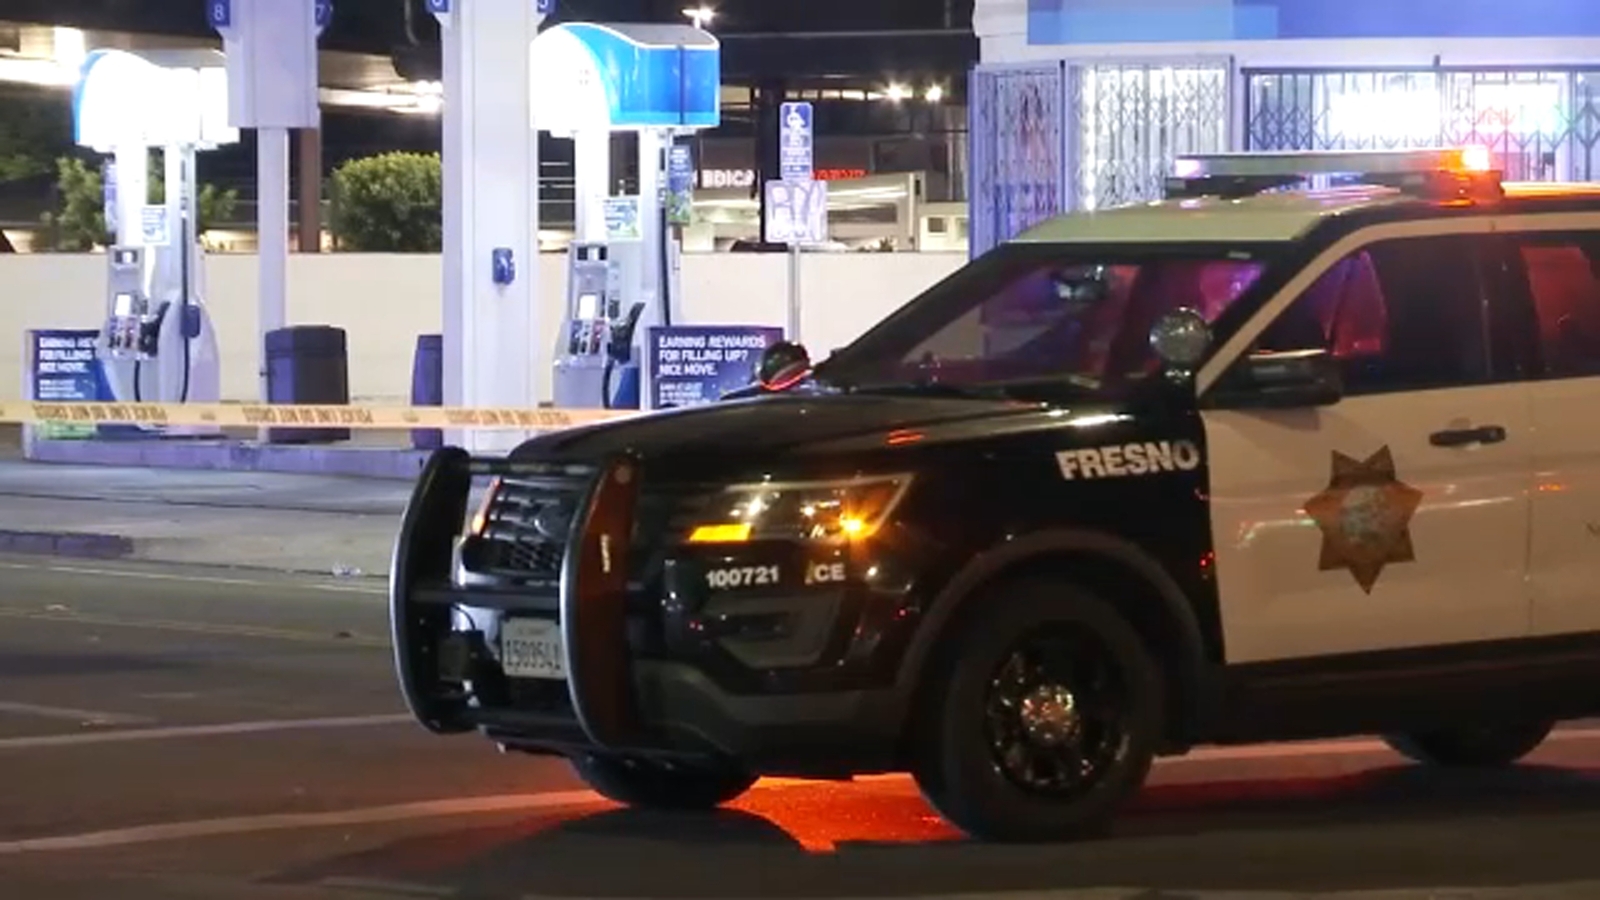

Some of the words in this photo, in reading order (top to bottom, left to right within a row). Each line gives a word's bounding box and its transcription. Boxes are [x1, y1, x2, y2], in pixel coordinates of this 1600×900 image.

[214, 4, 224, 21] 8
[316, 4, 325, 19] 7
[660, 335, 706, 348] EARNING
[708, 335, 766, 348] REWARDS
[660, 350, 681, 362] FOR
[682, 350, 723, 362] FILLING
[725, 350, 748, 362] UP?
[660, 363, 682, 376] NICE
[684, 363, 718, 376] MOVE.
[68, 405, 90, 421] NOT
[108, 405, 131, 421] LINE
[131, 405, 167, 421] POLICE
[278, 407, 298, 423] NOT
[316, 407, 337, 423] LINE
[337, 407, 374, 423] POLICE
[1055, 440, 1199, 480] FRESNO
[706, 564, 779, 588] 100721
